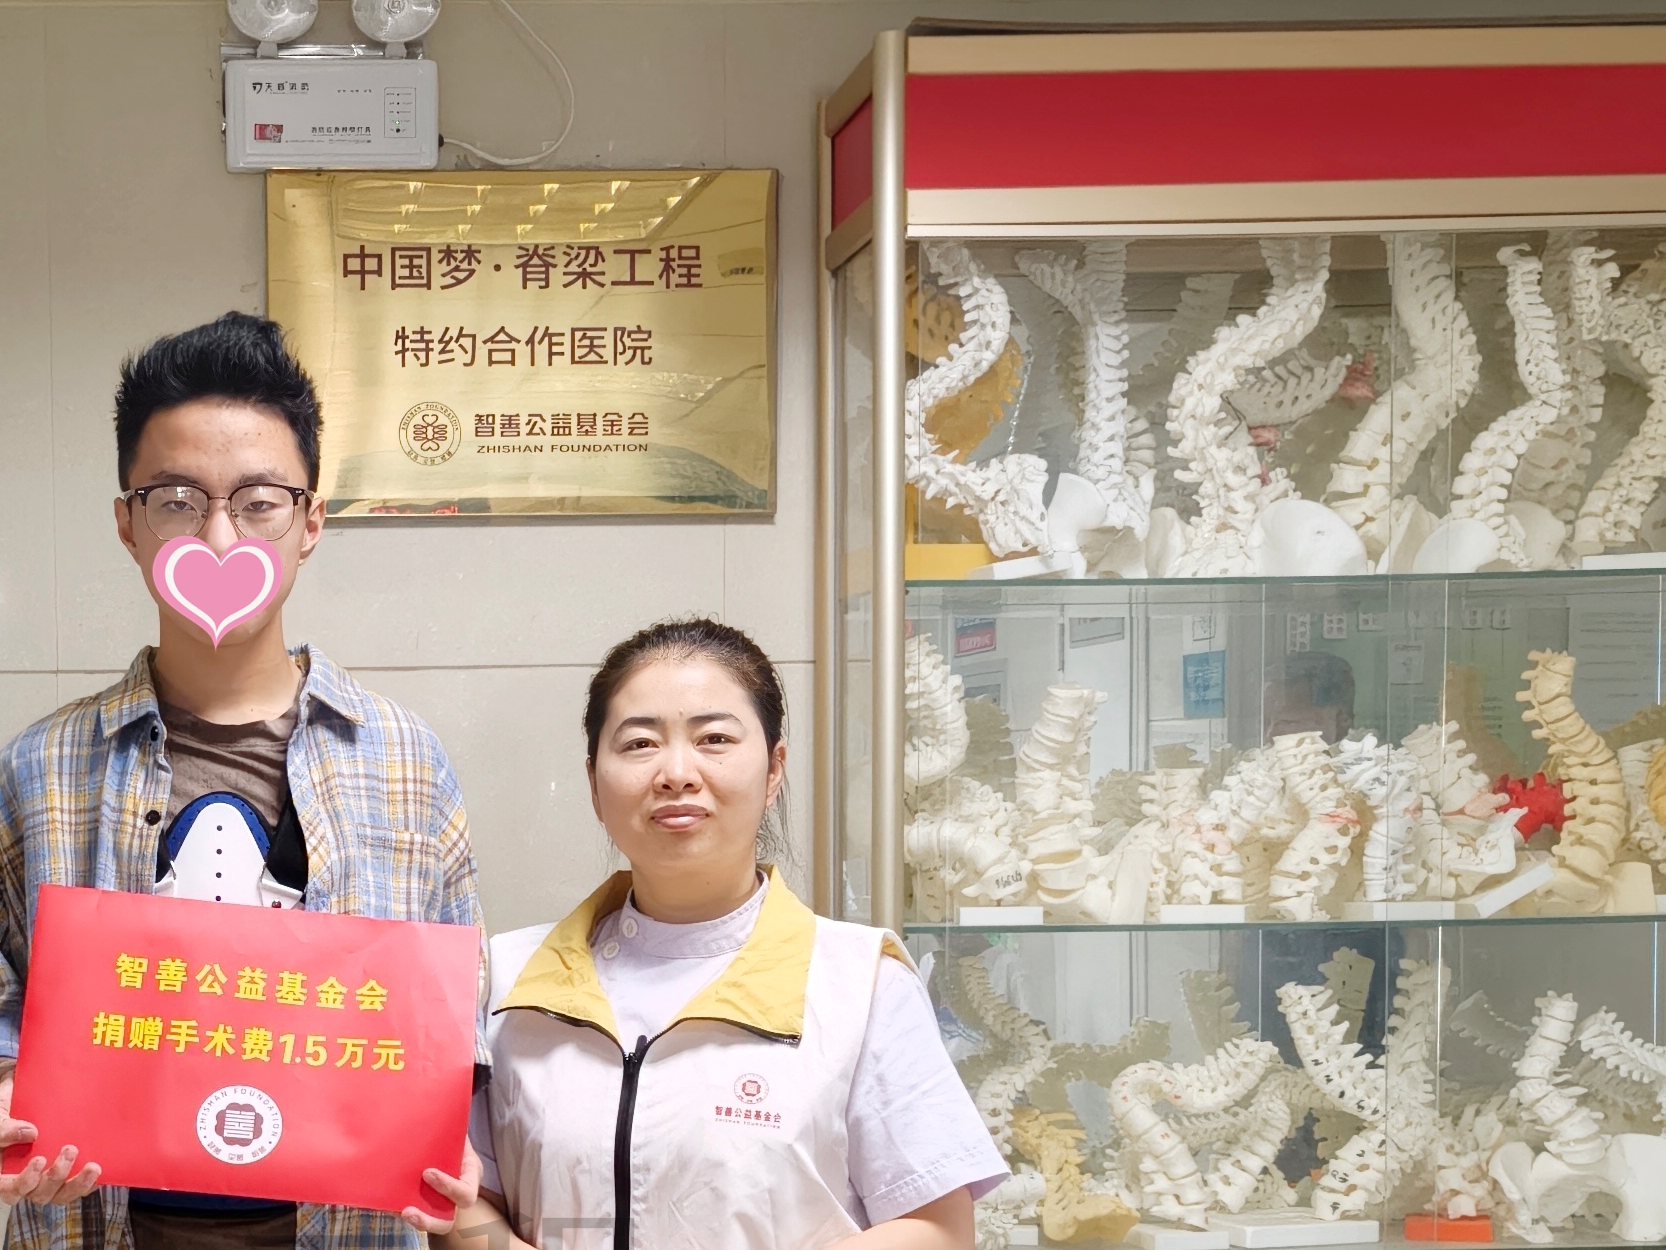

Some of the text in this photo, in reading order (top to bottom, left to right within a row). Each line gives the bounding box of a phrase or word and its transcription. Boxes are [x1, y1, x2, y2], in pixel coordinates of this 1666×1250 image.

[342, 244, 704, 291] 中国梦·脊梁工程
[394, 324, 653, 368] 特约合作医院
[474, 412, 649, 438] 智善公益基金会
[477, 443, 648, 454] ZHISHAN FOUNDATION
[115, 952, 389, 1012] 智善公益基金会
[92, 1011, 405, 1071] 捐赠手术费1.5万元
